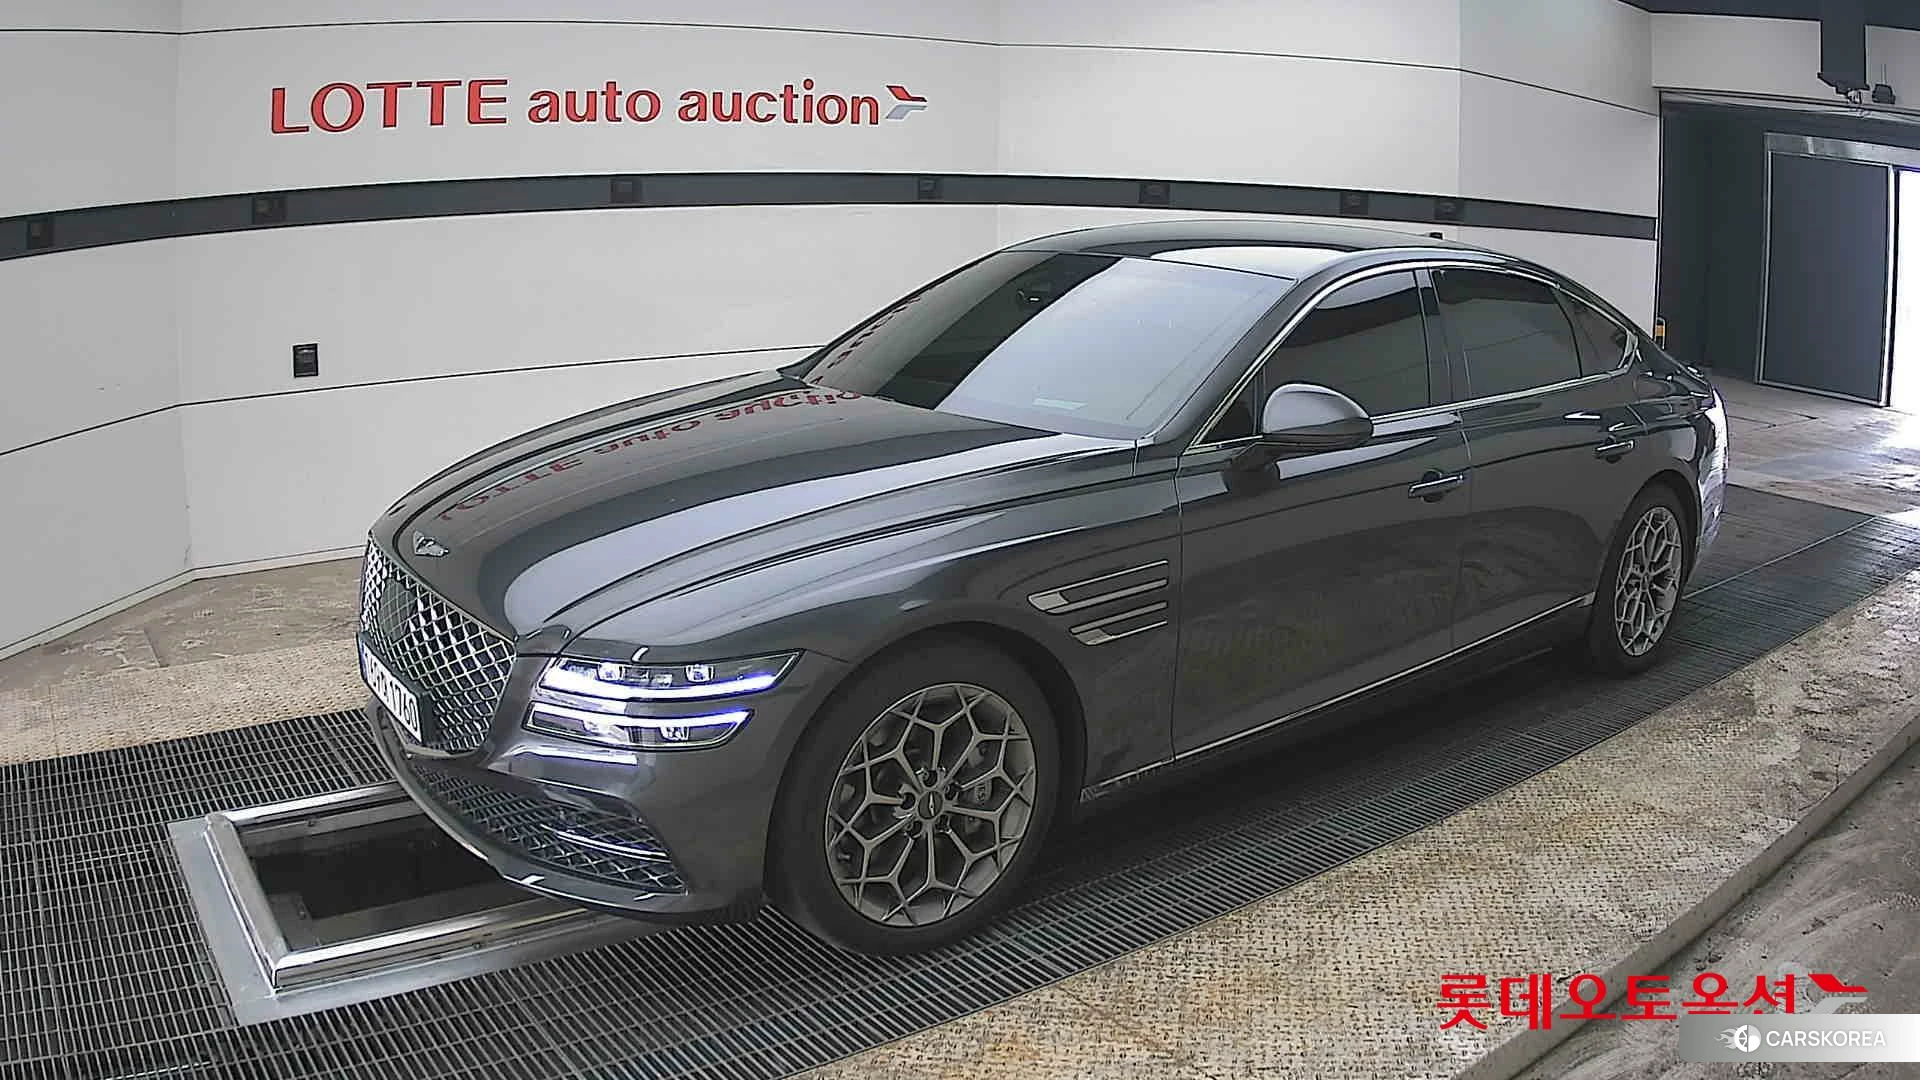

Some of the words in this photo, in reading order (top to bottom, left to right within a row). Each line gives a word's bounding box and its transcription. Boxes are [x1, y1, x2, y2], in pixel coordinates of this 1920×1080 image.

[271, 80, 508, 134] LOTTE
[528, 81, 660, 123] auto
[678, 78, 879, 125] auction
